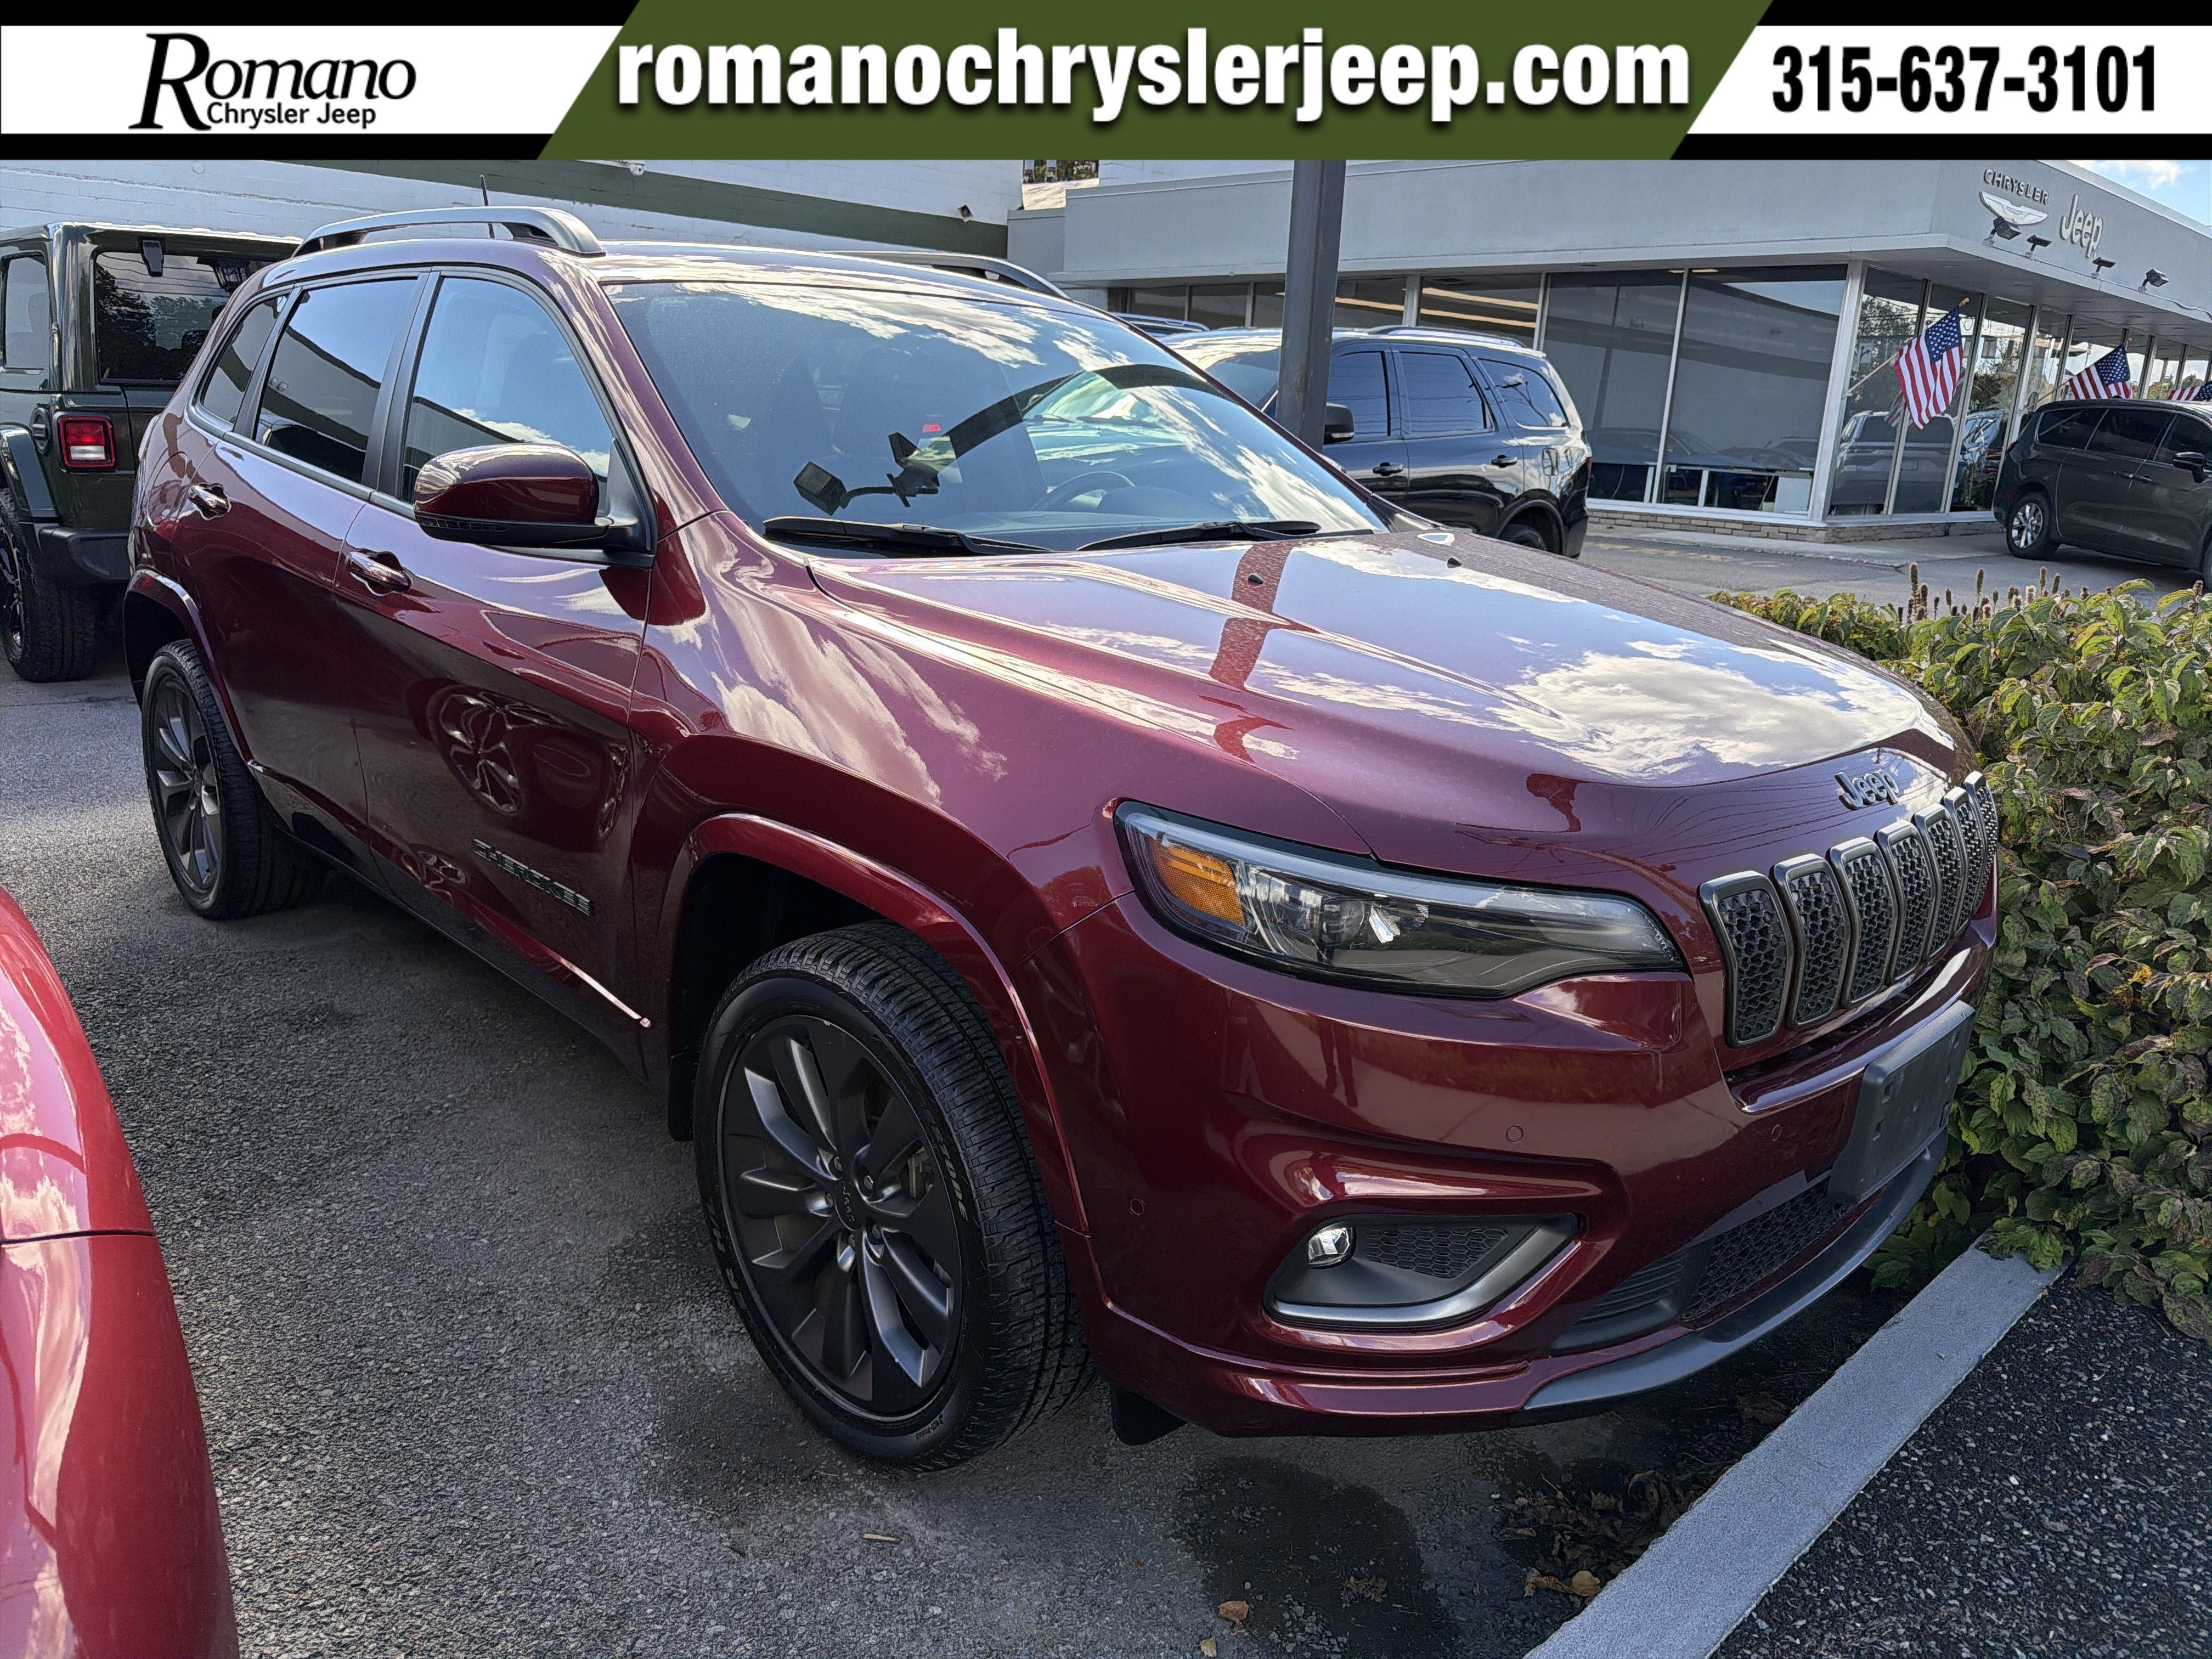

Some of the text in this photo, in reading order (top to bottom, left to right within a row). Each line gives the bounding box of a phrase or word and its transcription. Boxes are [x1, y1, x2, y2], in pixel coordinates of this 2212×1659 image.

[1983, 168, 2050, 205] CHRYSLER
[2059, 194, 2104, 258] Jeep
[1835, 769, 1899, 810] Jeep
